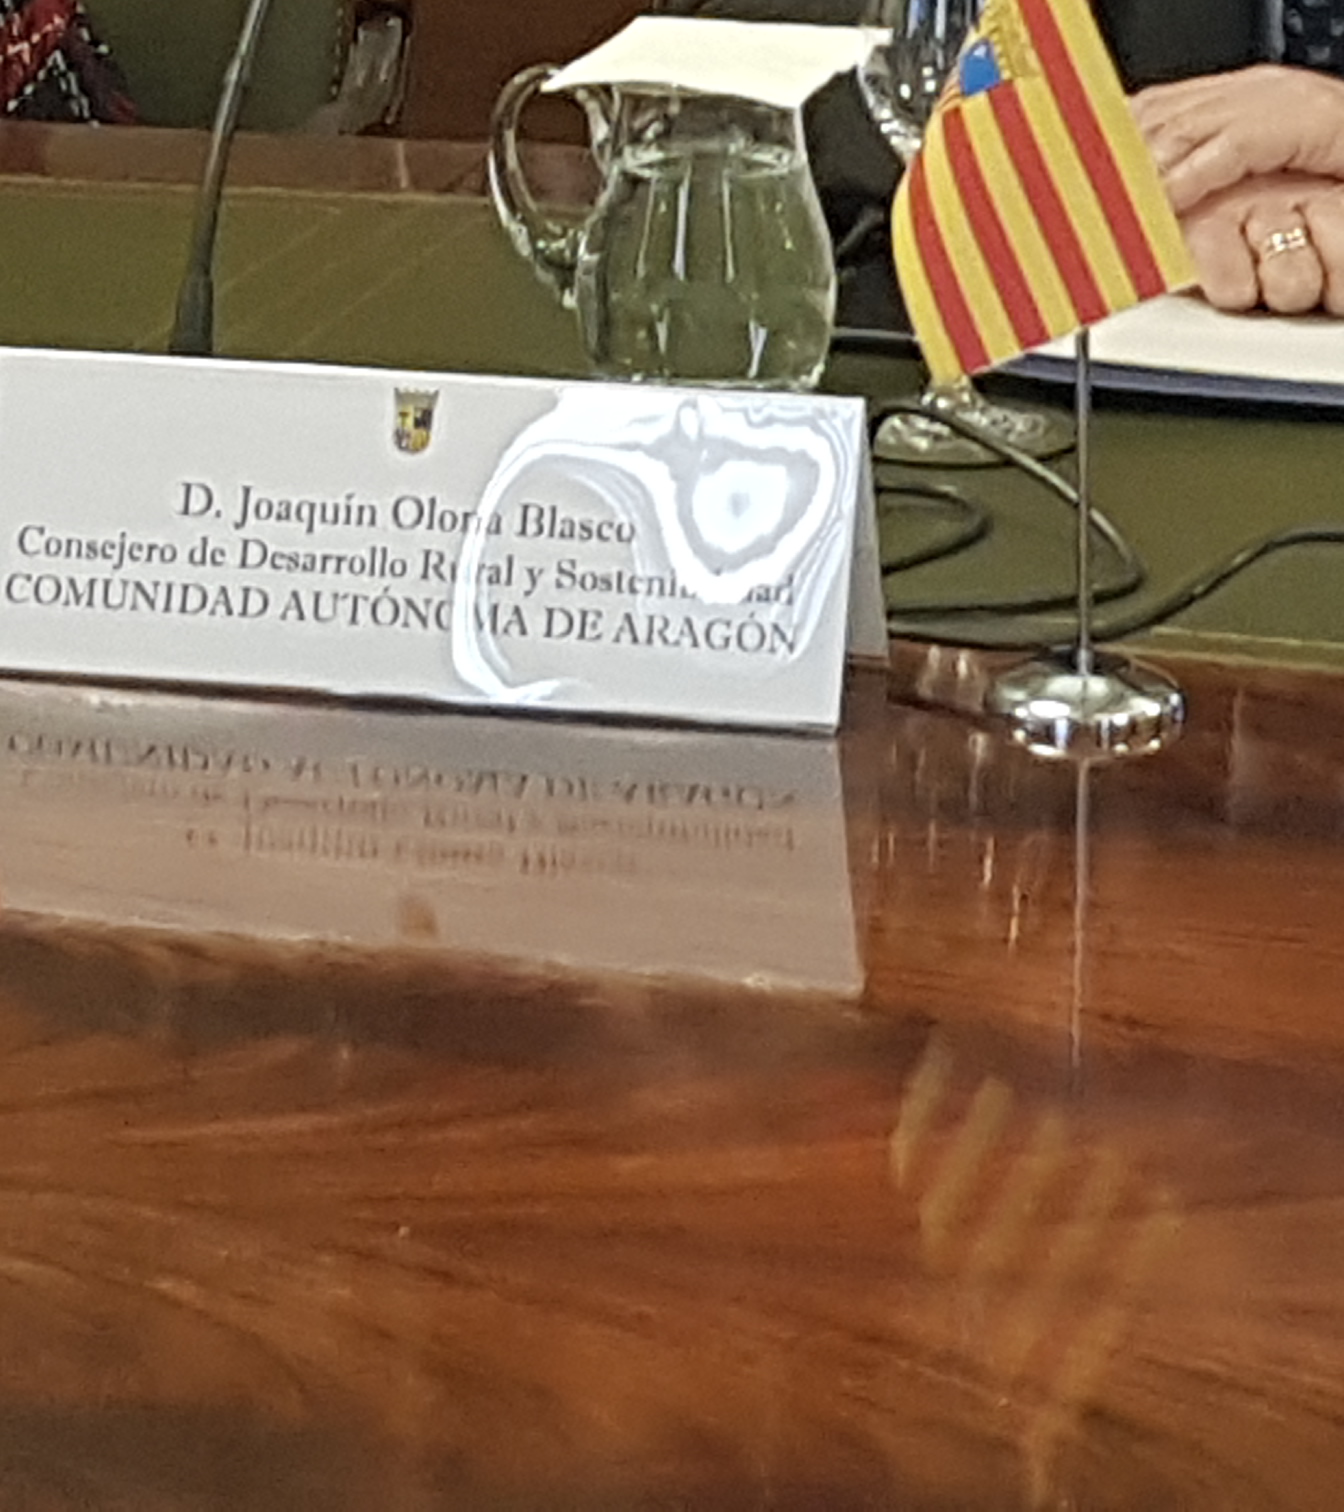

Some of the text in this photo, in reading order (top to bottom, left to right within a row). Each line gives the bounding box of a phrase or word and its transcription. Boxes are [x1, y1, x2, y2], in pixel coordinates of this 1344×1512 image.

[175, 482, 222, 519] D.
[233, 485, 377, 534] Joaquín
[515, 502, 636, 543] Blasco
[18, 524, 178, 570] Consejero
[188, 536, 226, 568] de
[238, 537, 407, 579] Desarrollo
[524, 567, 545, 598] y
[5, 571, 270, 619] COMUNIDAD
[542, 606, 604, 641] DE
[612, 610, 796, 656] ARAGÓN
